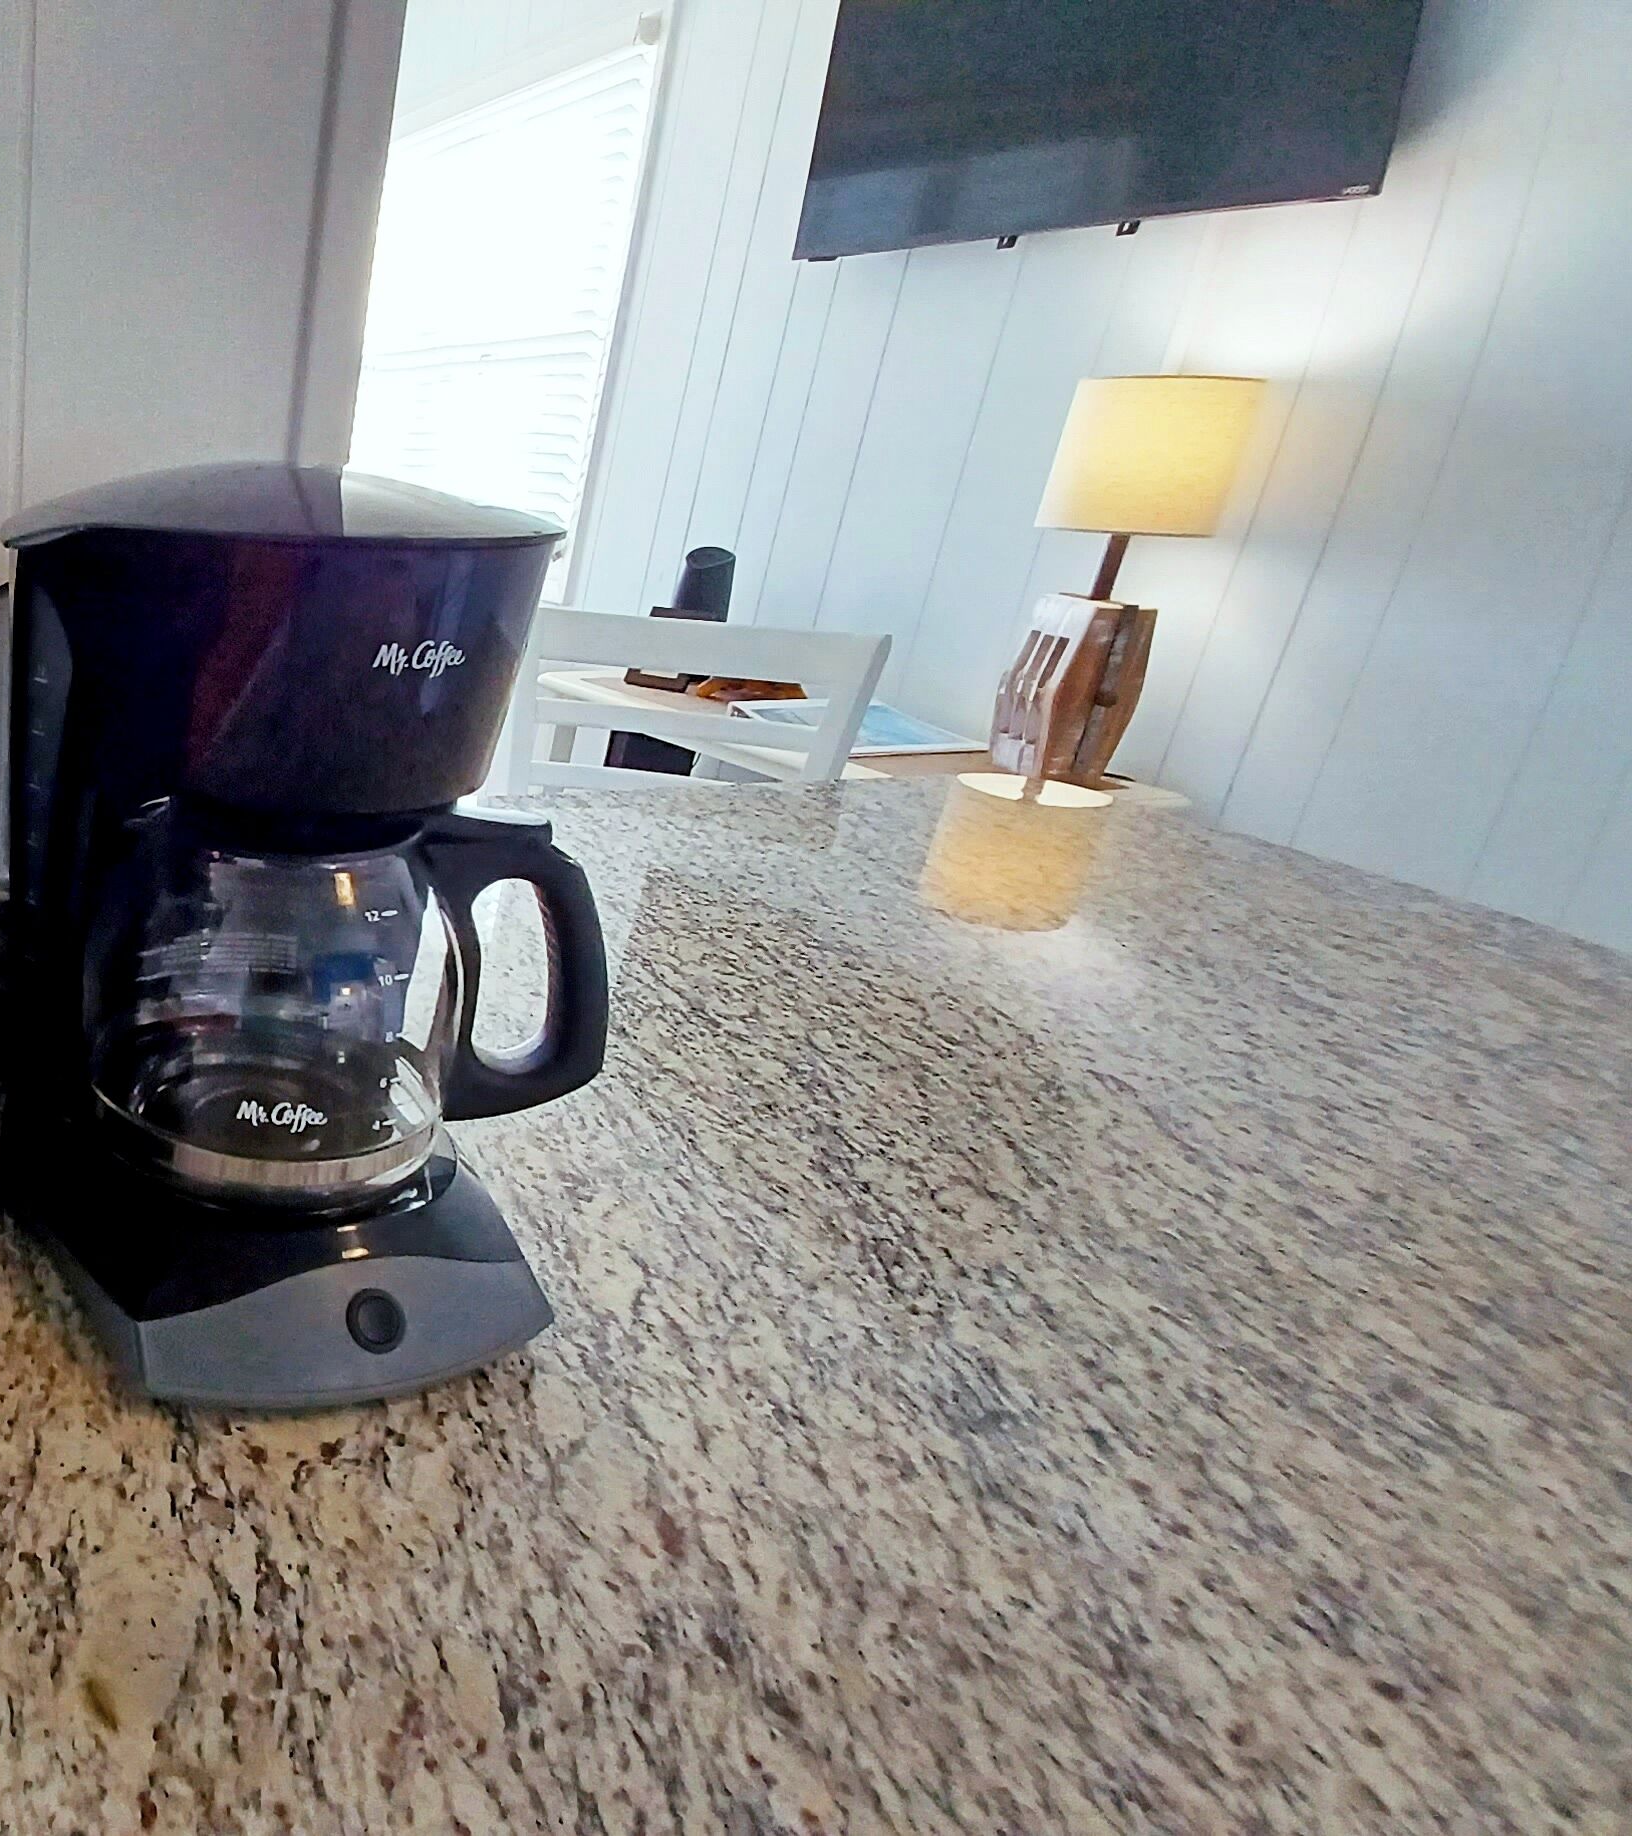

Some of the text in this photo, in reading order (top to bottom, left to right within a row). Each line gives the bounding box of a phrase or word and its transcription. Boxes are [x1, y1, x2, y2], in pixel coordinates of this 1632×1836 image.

[372, 640, 465, 678] Mr. Coffee
[364, 910, 381, 922] 12
[378, 974, 394, 987] 10
[236, 1100, 328, 1133] Mr. Coffee
